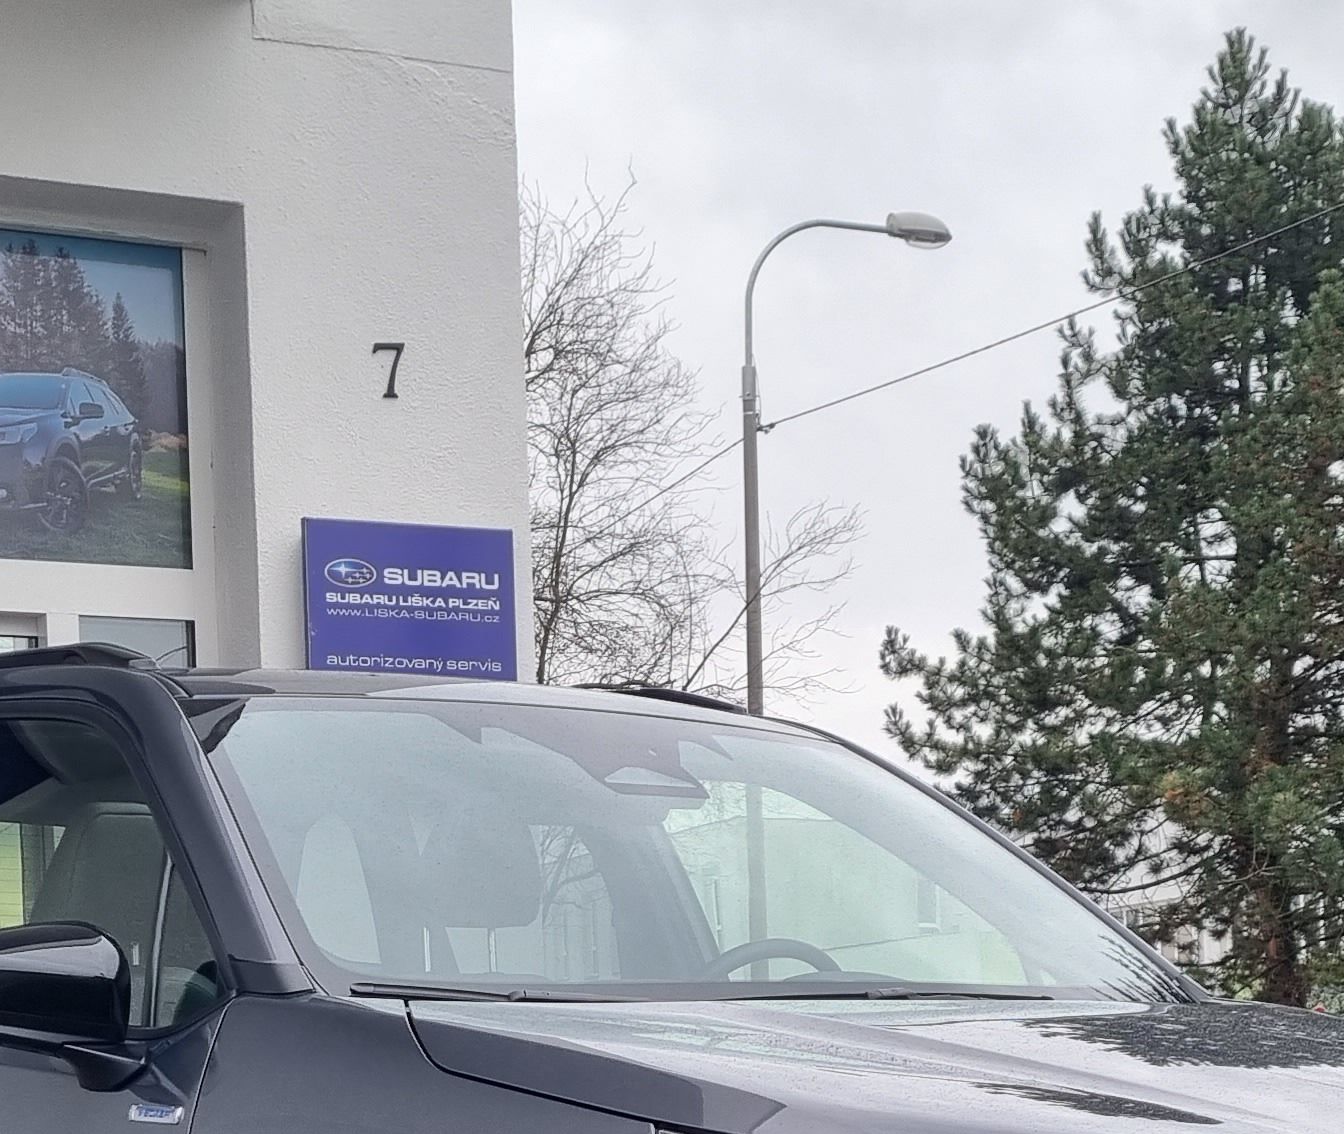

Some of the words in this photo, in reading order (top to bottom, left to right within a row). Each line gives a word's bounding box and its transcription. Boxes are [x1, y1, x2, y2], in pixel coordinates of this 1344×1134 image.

[372, 342, 405, 398] 7
[383, 567, 500, 590] SUBARU
[325, 592, 397, 606] SUBARU
[399, 593, 446, 608] LIŠKA
[448, 597, 500, 610] PLZEŇ
[326, 607, 501, 623] www.LISKA-SUBARU.cz
[326, 653, 444, 673] autorizovaný
[446, 658, 502, 672] servis
